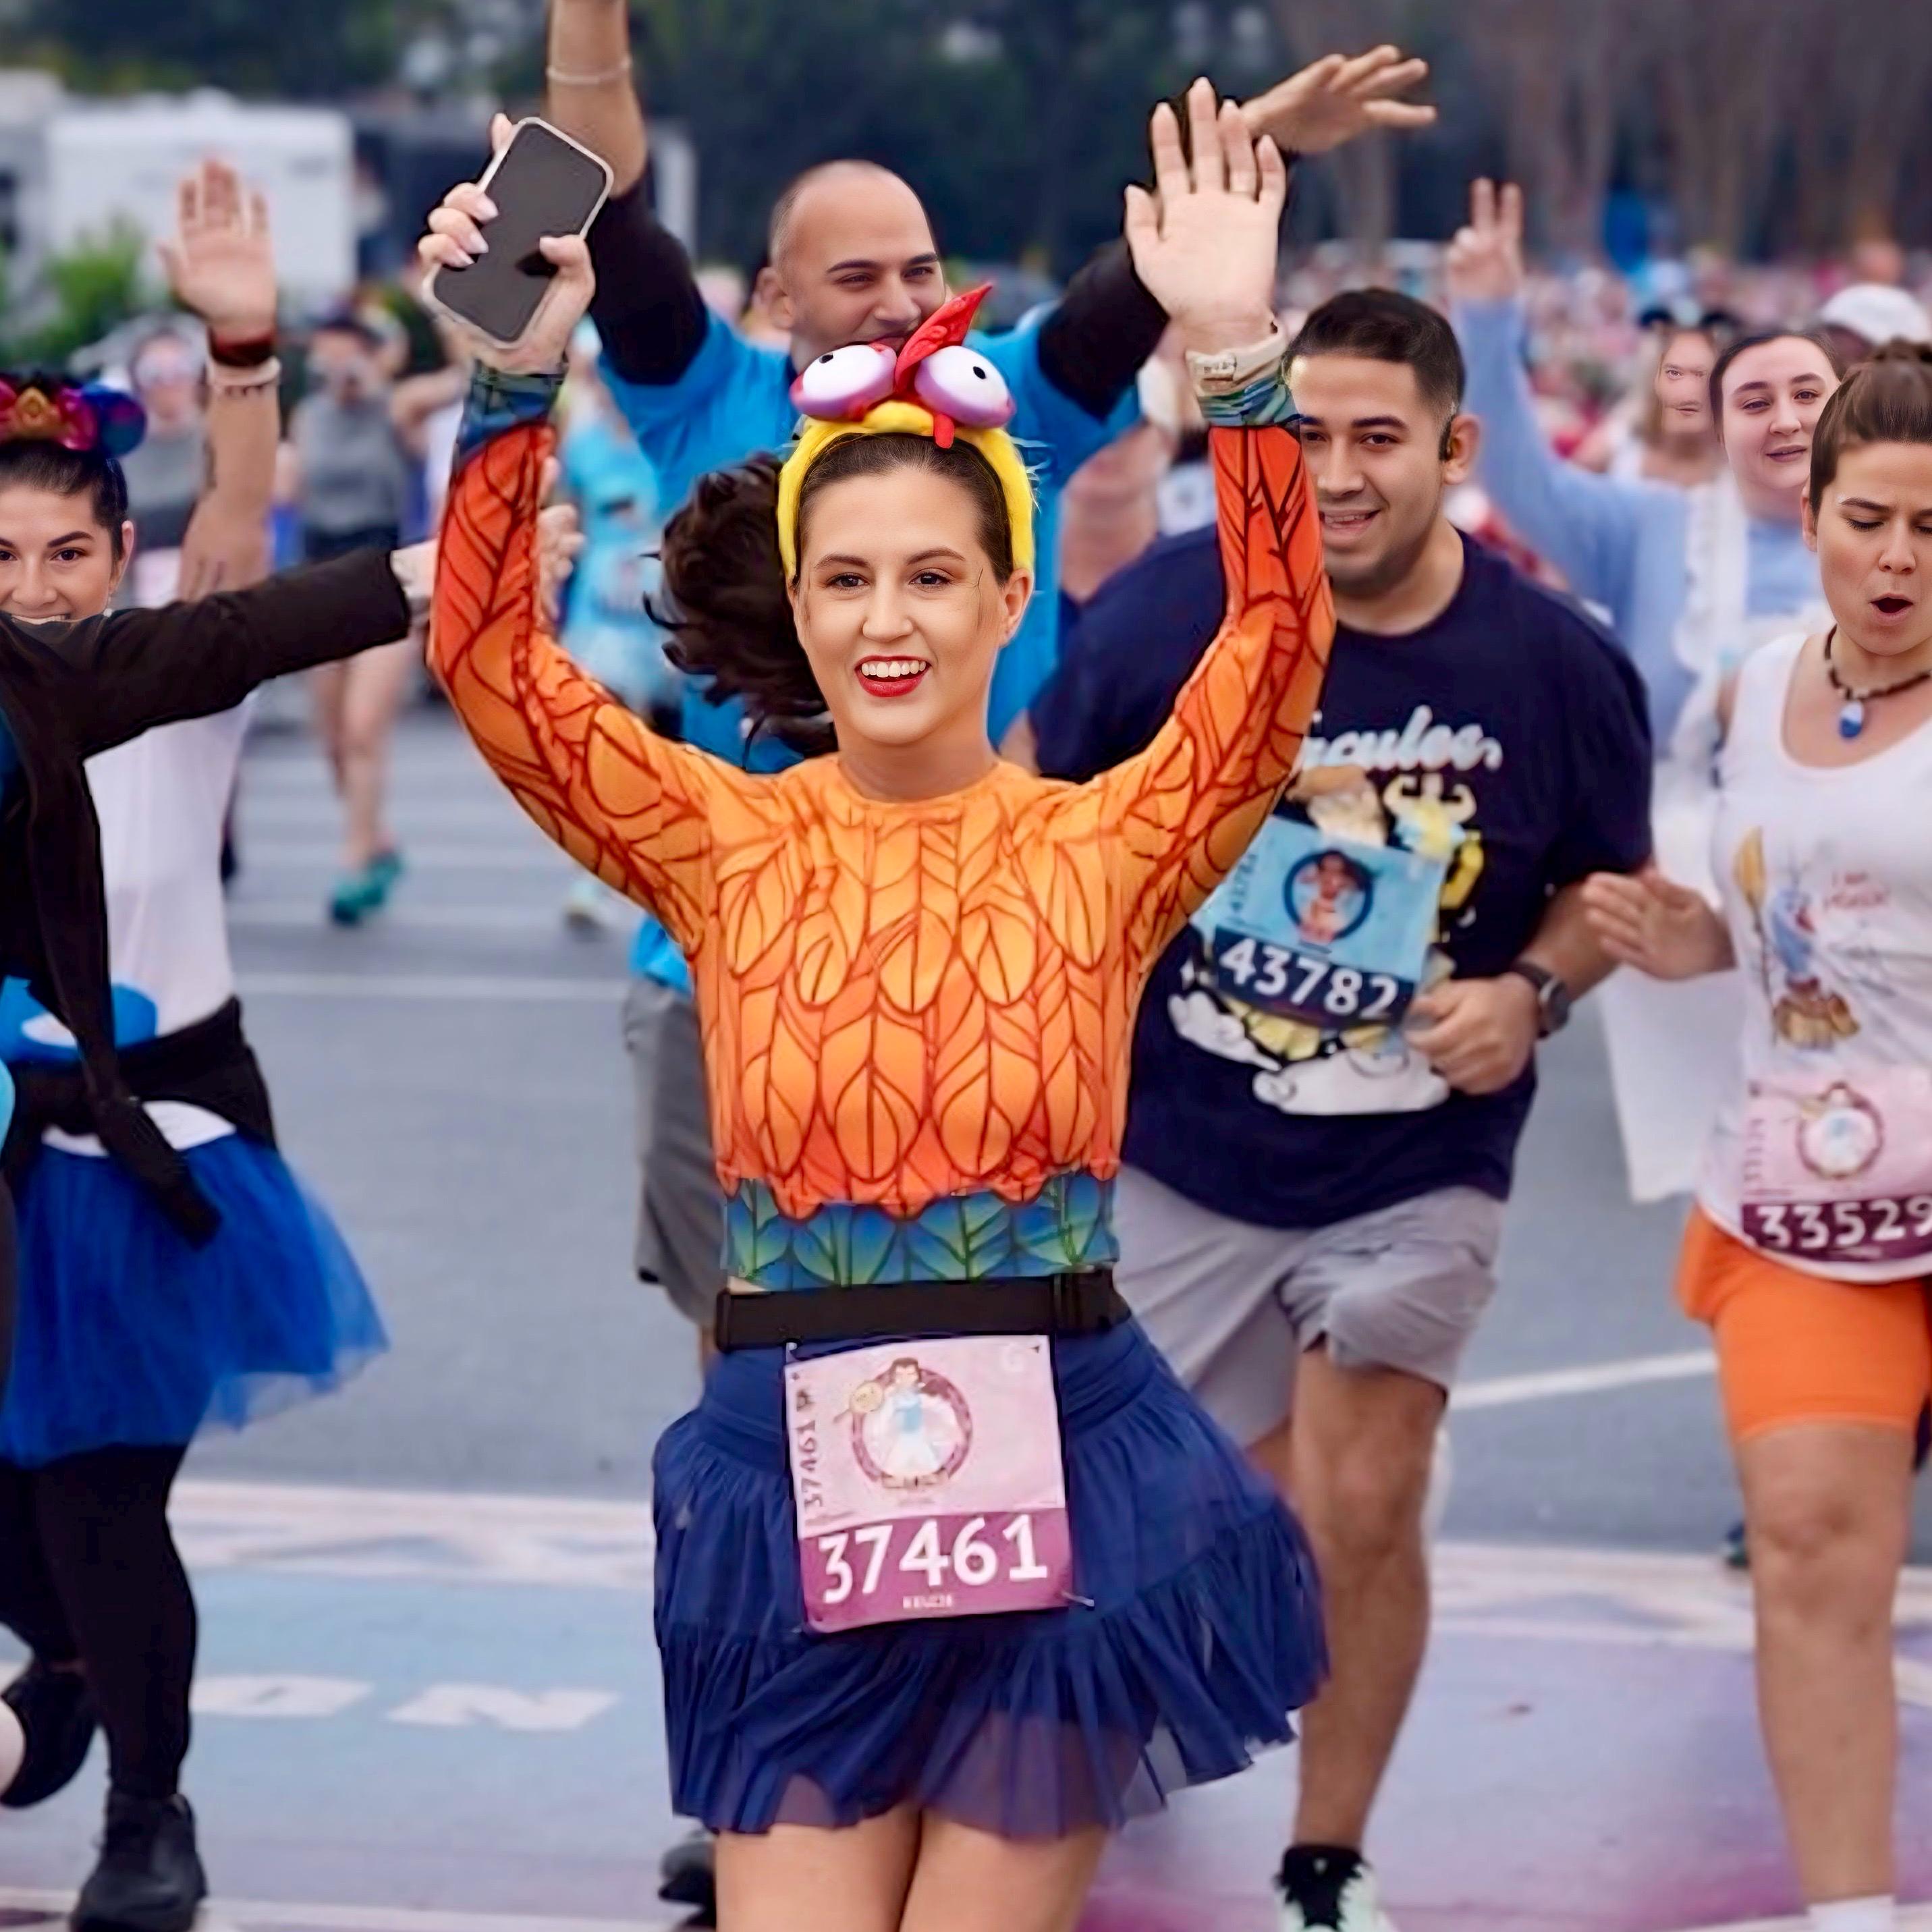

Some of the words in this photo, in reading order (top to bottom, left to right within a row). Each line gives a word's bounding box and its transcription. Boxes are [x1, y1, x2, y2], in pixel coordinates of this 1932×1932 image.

[1219, 937, 1400, 1017] 43782
[1757, 1195, 1932, 1249] 33529
[818, 1514, 1048, 1605] 37461
